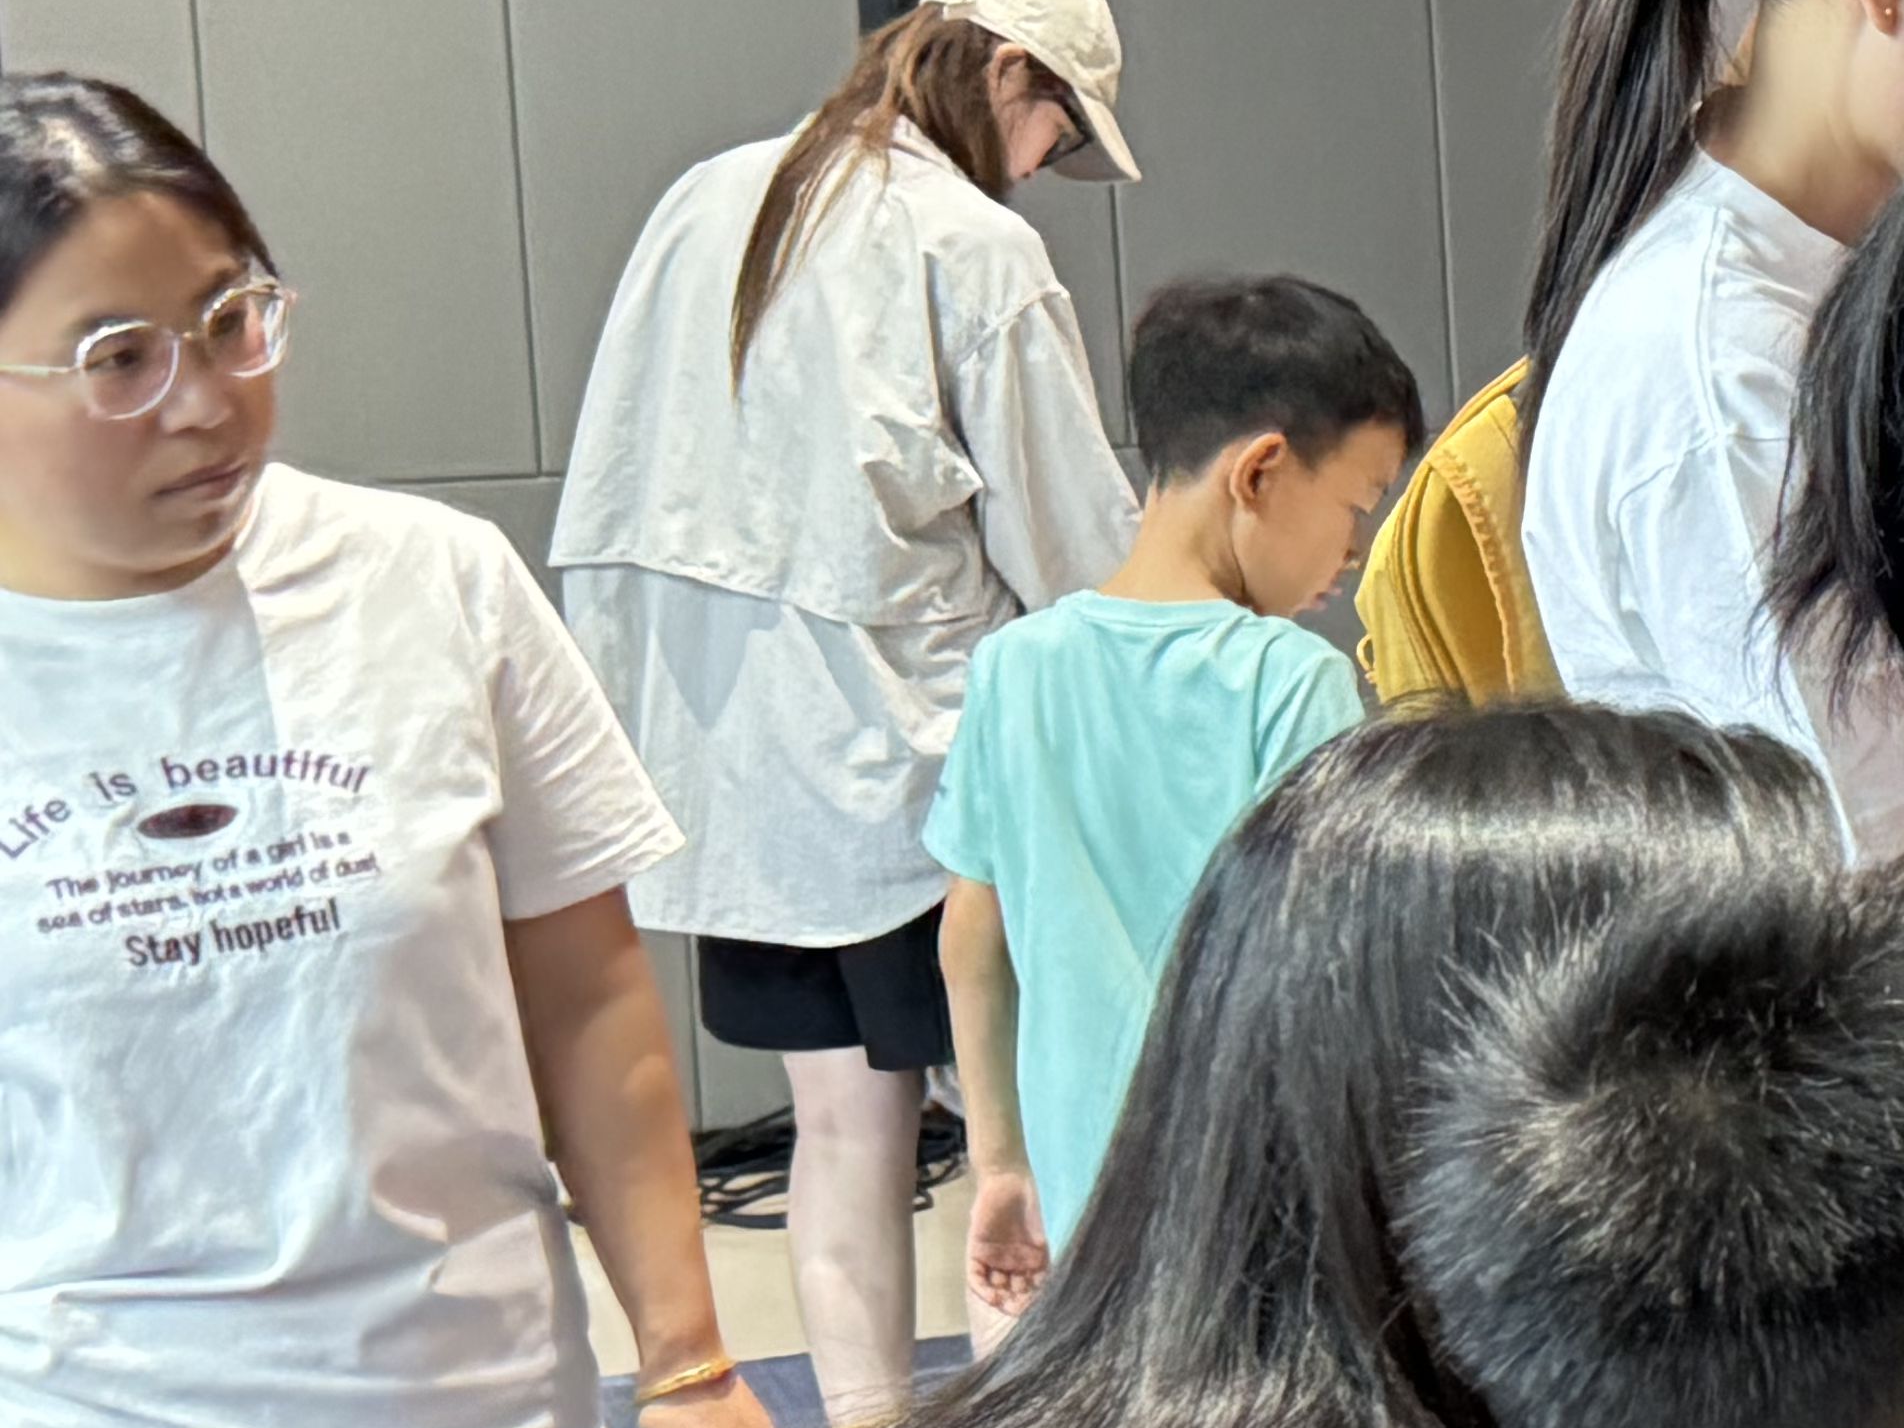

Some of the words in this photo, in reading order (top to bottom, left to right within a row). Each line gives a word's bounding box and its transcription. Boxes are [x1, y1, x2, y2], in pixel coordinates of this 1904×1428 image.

[89, 771, 138, 801] is
[160, 748, 371, 794] beautiful
[46, 876, 99, 899] The
[212, 848, 237, 872] of
[88, 900, 114, 925] of
[309, 860, 329, 883] of
[125, 930, 202, 967] Stay
[210, 897, 341, 954] hopeful
